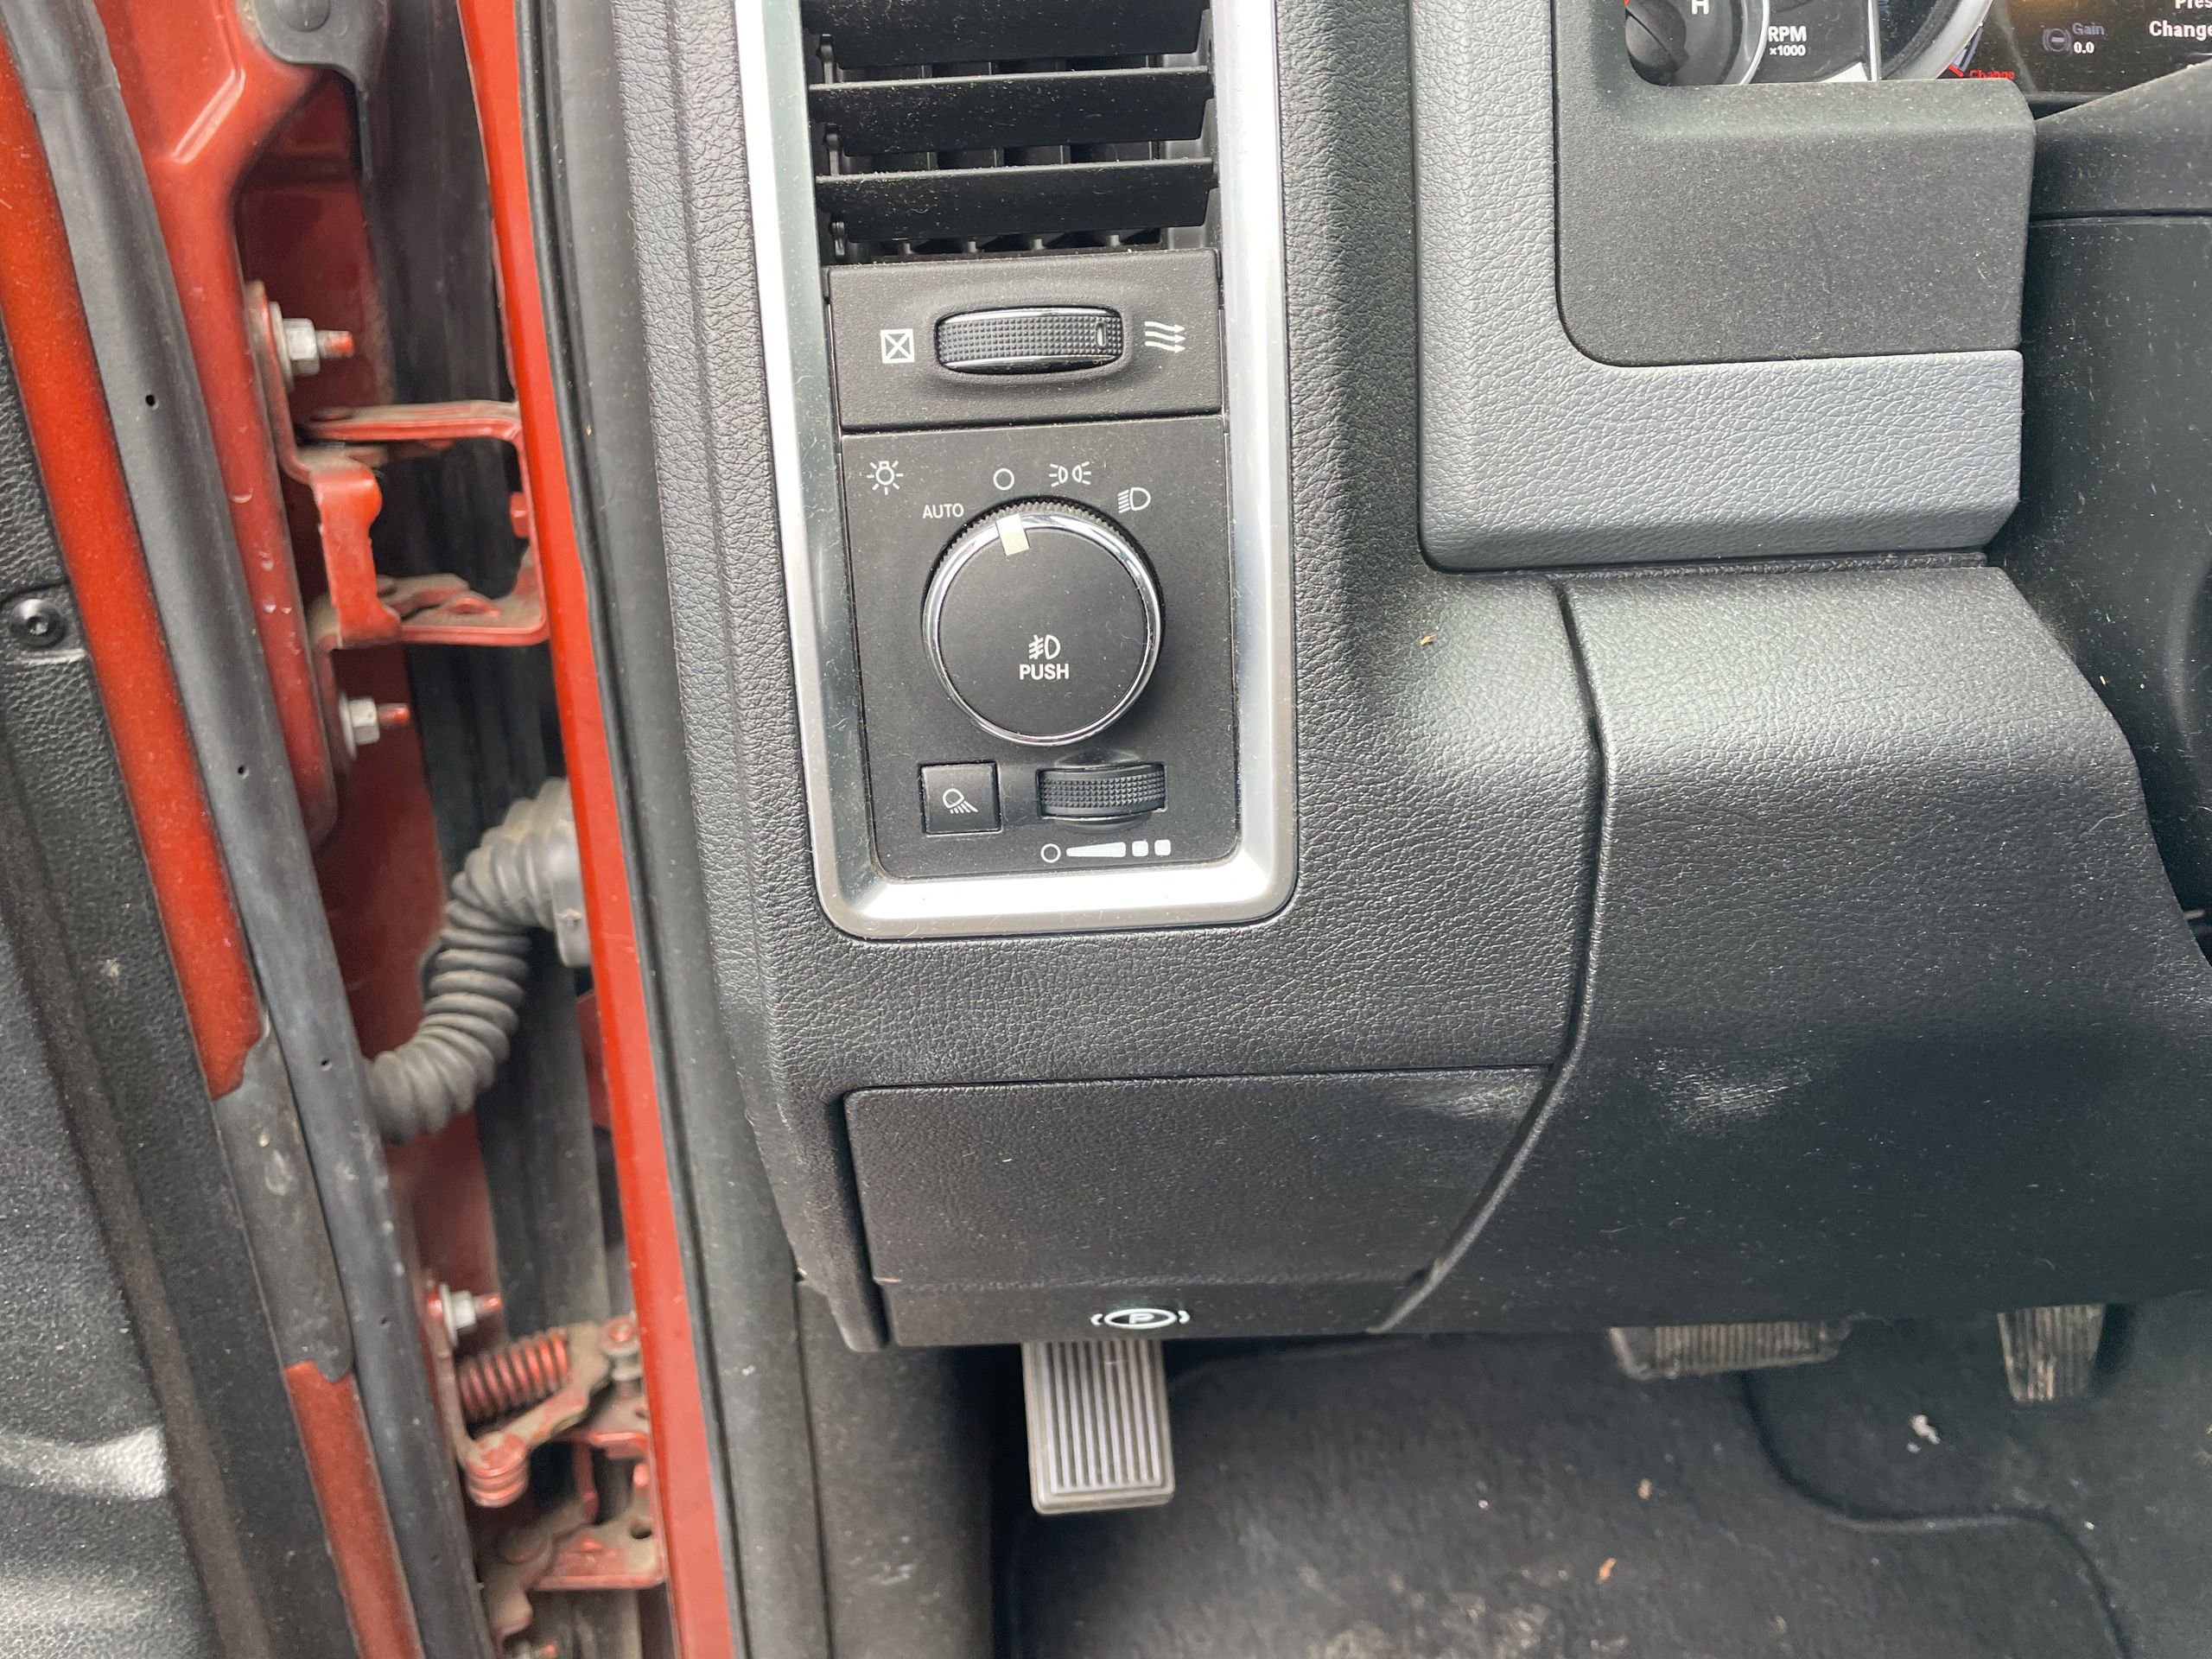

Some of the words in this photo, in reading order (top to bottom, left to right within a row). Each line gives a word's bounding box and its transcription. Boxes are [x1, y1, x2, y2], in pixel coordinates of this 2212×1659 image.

[1768, 25, 1808, 42] RPM
[2072, 22, 2106, 35] Gain
[1769, 44, 1807, 56] x1000
[2074, 41, 2095, 54] 0.0
[922, 502, 964, 519] AUTO
[1019, 663, 1070, 681] PUSH
